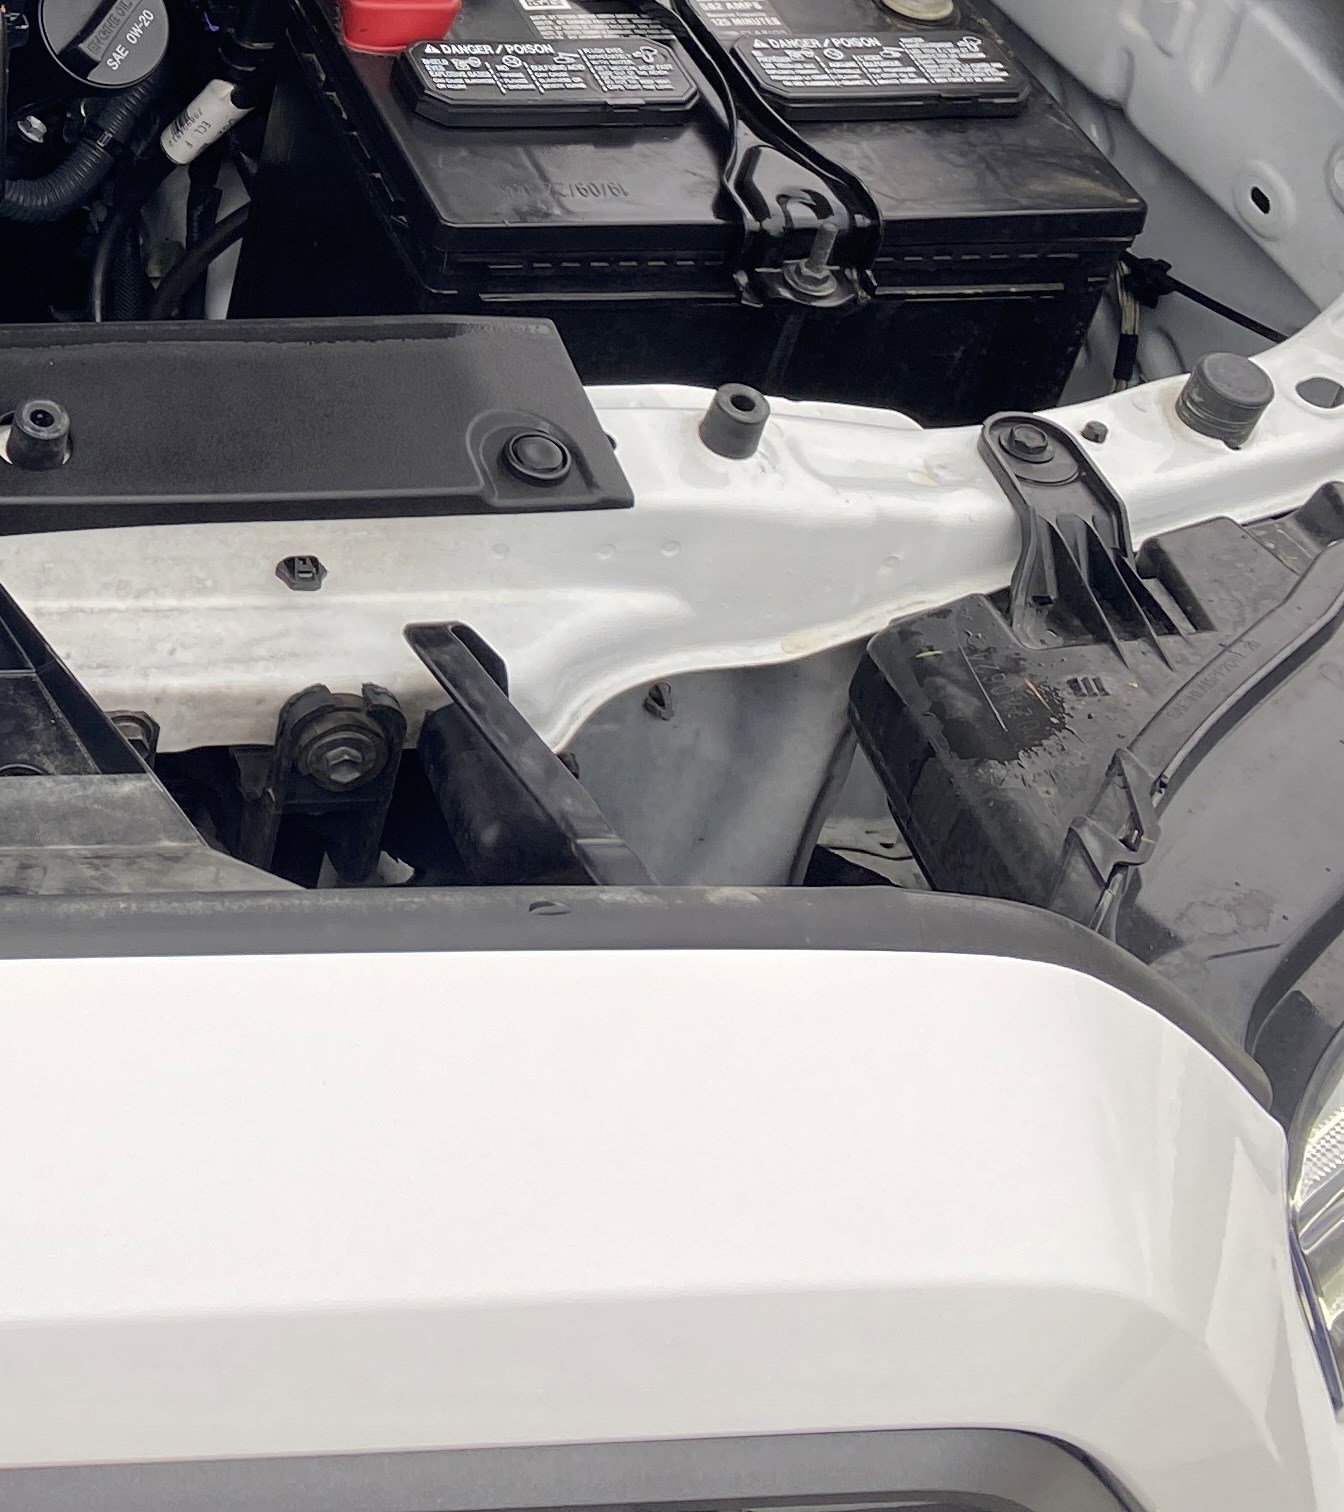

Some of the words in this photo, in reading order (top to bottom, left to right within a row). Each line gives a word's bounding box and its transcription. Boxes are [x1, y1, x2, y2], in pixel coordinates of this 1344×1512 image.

[116, 0, 133, 18] OIL
[106, 44, 130, 71] SAE
[126, 9, 154, 45] 0W-20
[767, 38, 822, 48] DANGER
[830, 37, 882, 48] POISON
[439, 43, 494, 55] DANGER
[504, 43, 555, 55] POISON
